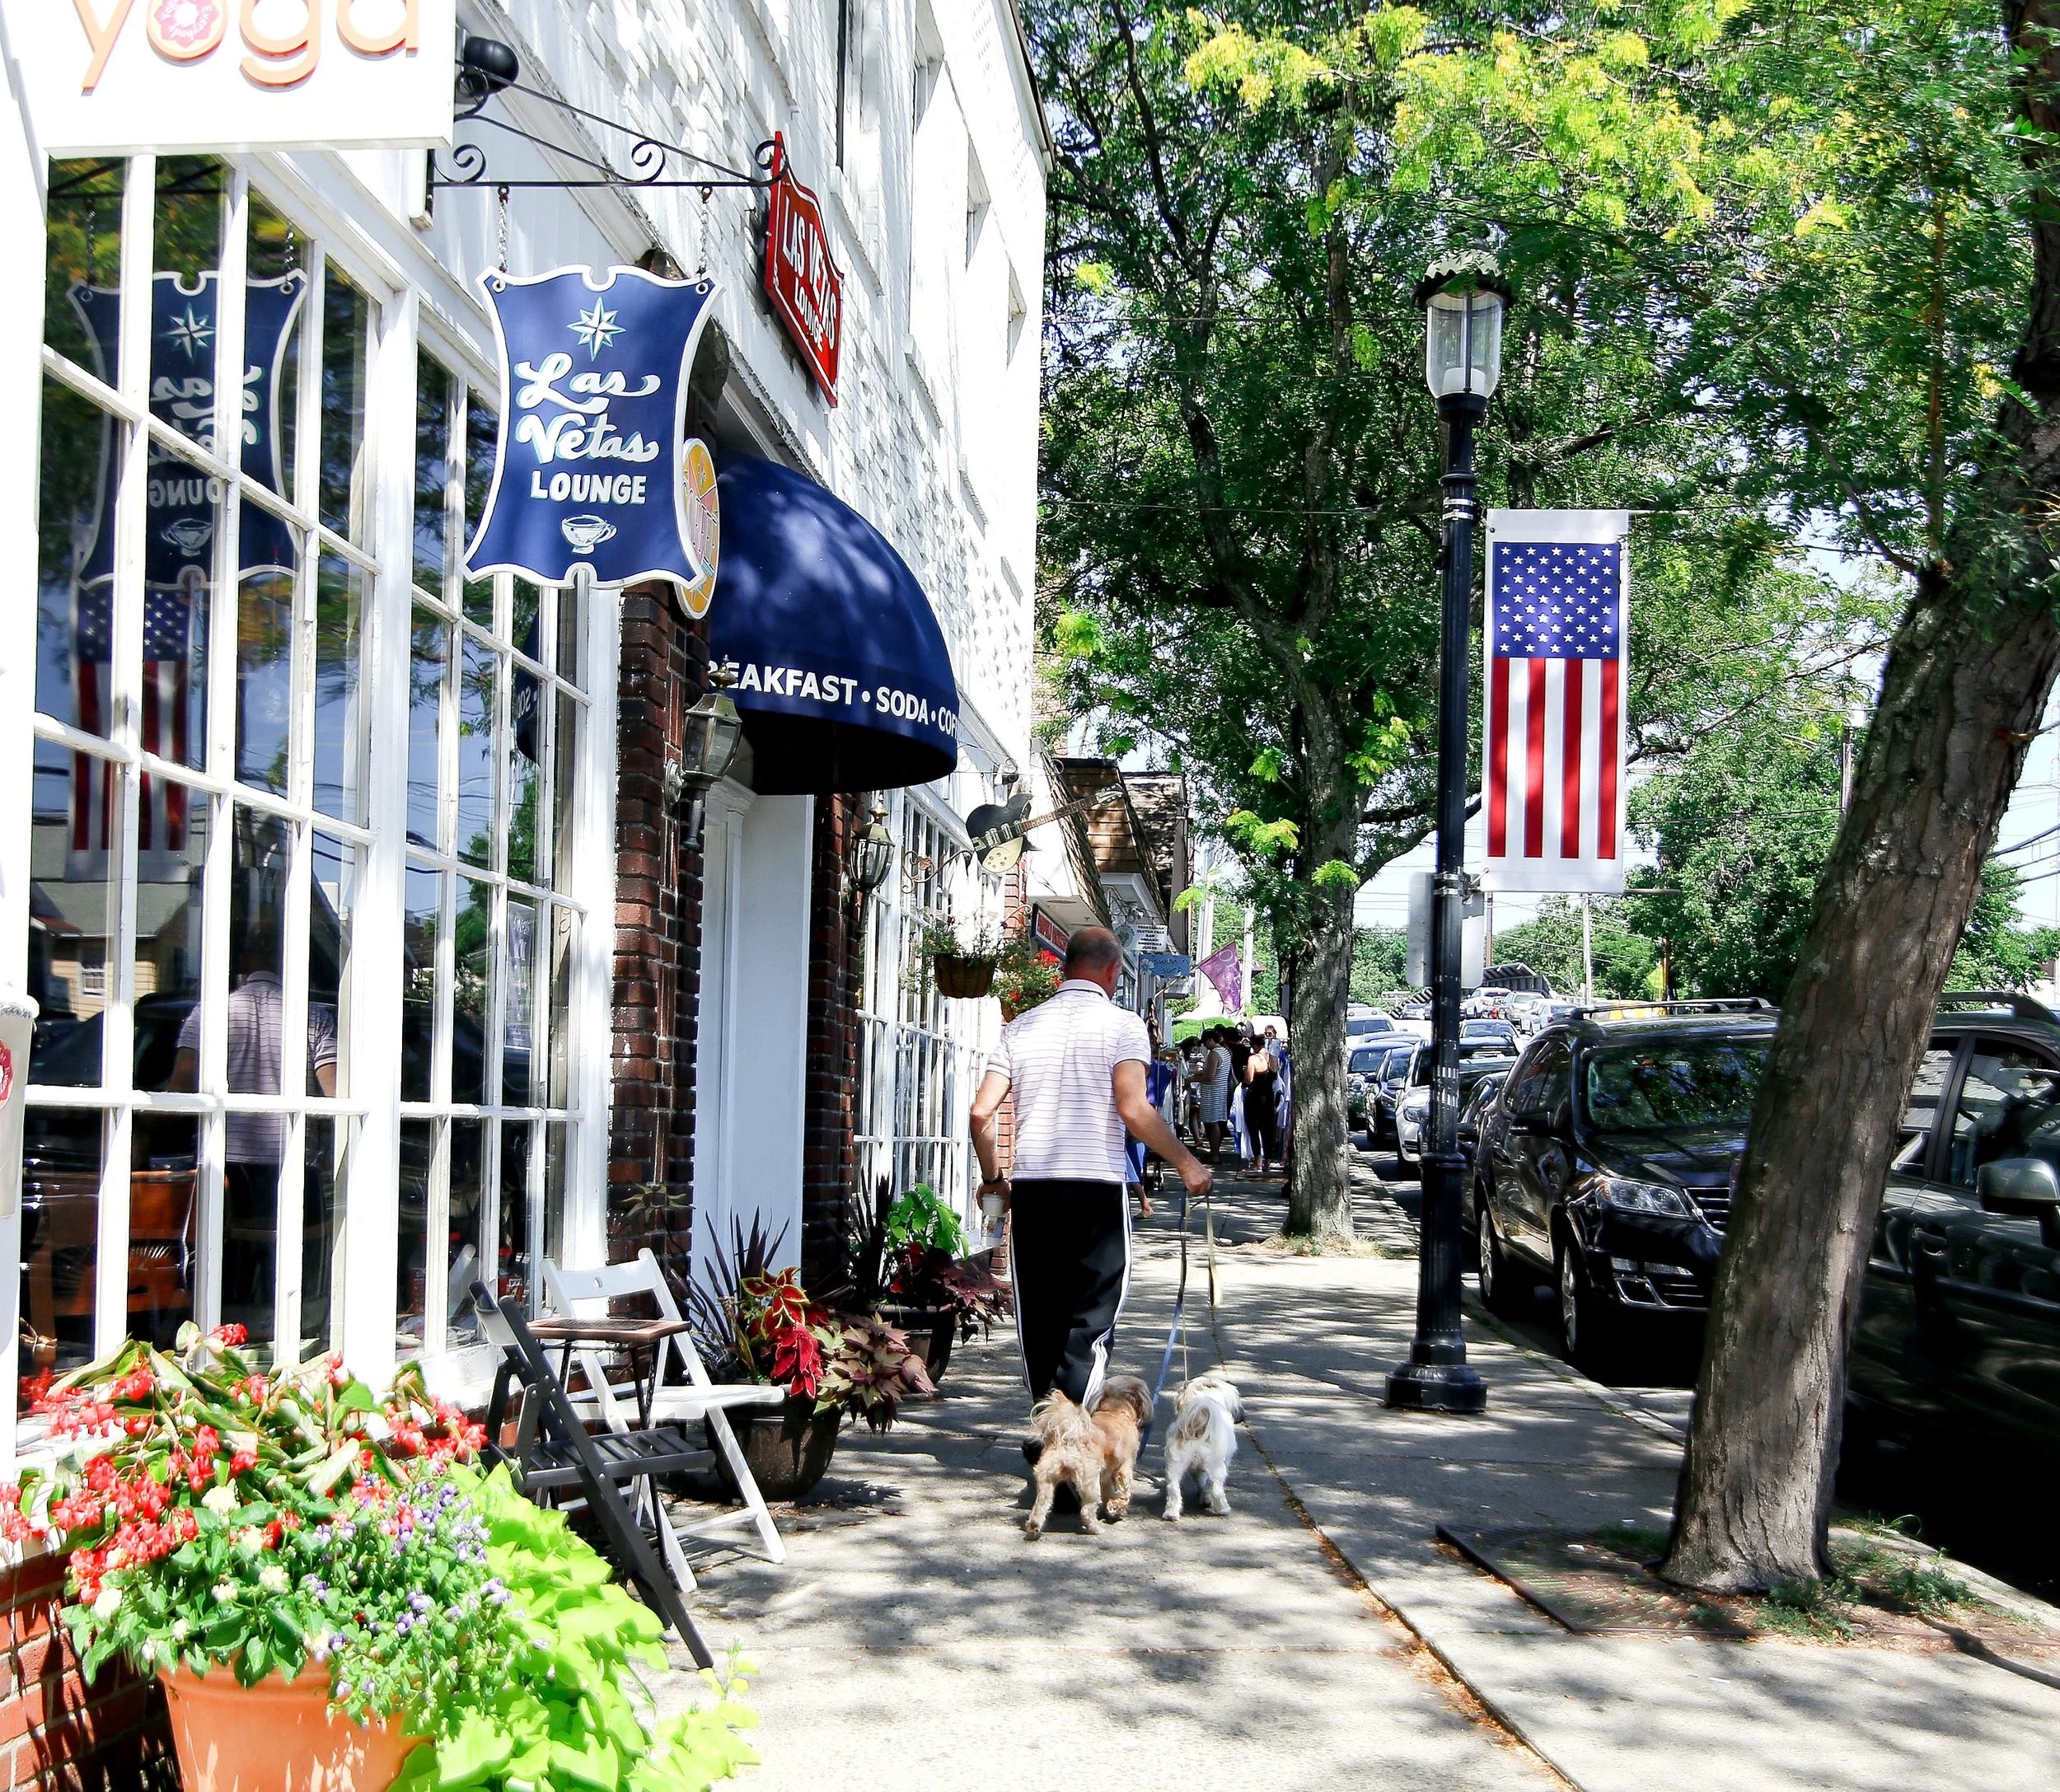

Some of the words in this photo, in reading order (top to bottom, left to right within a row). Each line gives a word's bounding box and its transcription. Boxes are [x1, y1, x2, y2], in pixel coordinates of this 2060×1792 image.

[71, 0, 419, 96] yoga
[783, 194, 806, 278] LAS
[809, 222, 836, 350] VETAS
[794, 276, 823, 353] LOUNGE
[514, 352, 661, 414] Las
[515, 413, 659, 465] Vetas
[531, 470, 647, 504] LOUNGE
[876, 686, 929, 725] SODA
